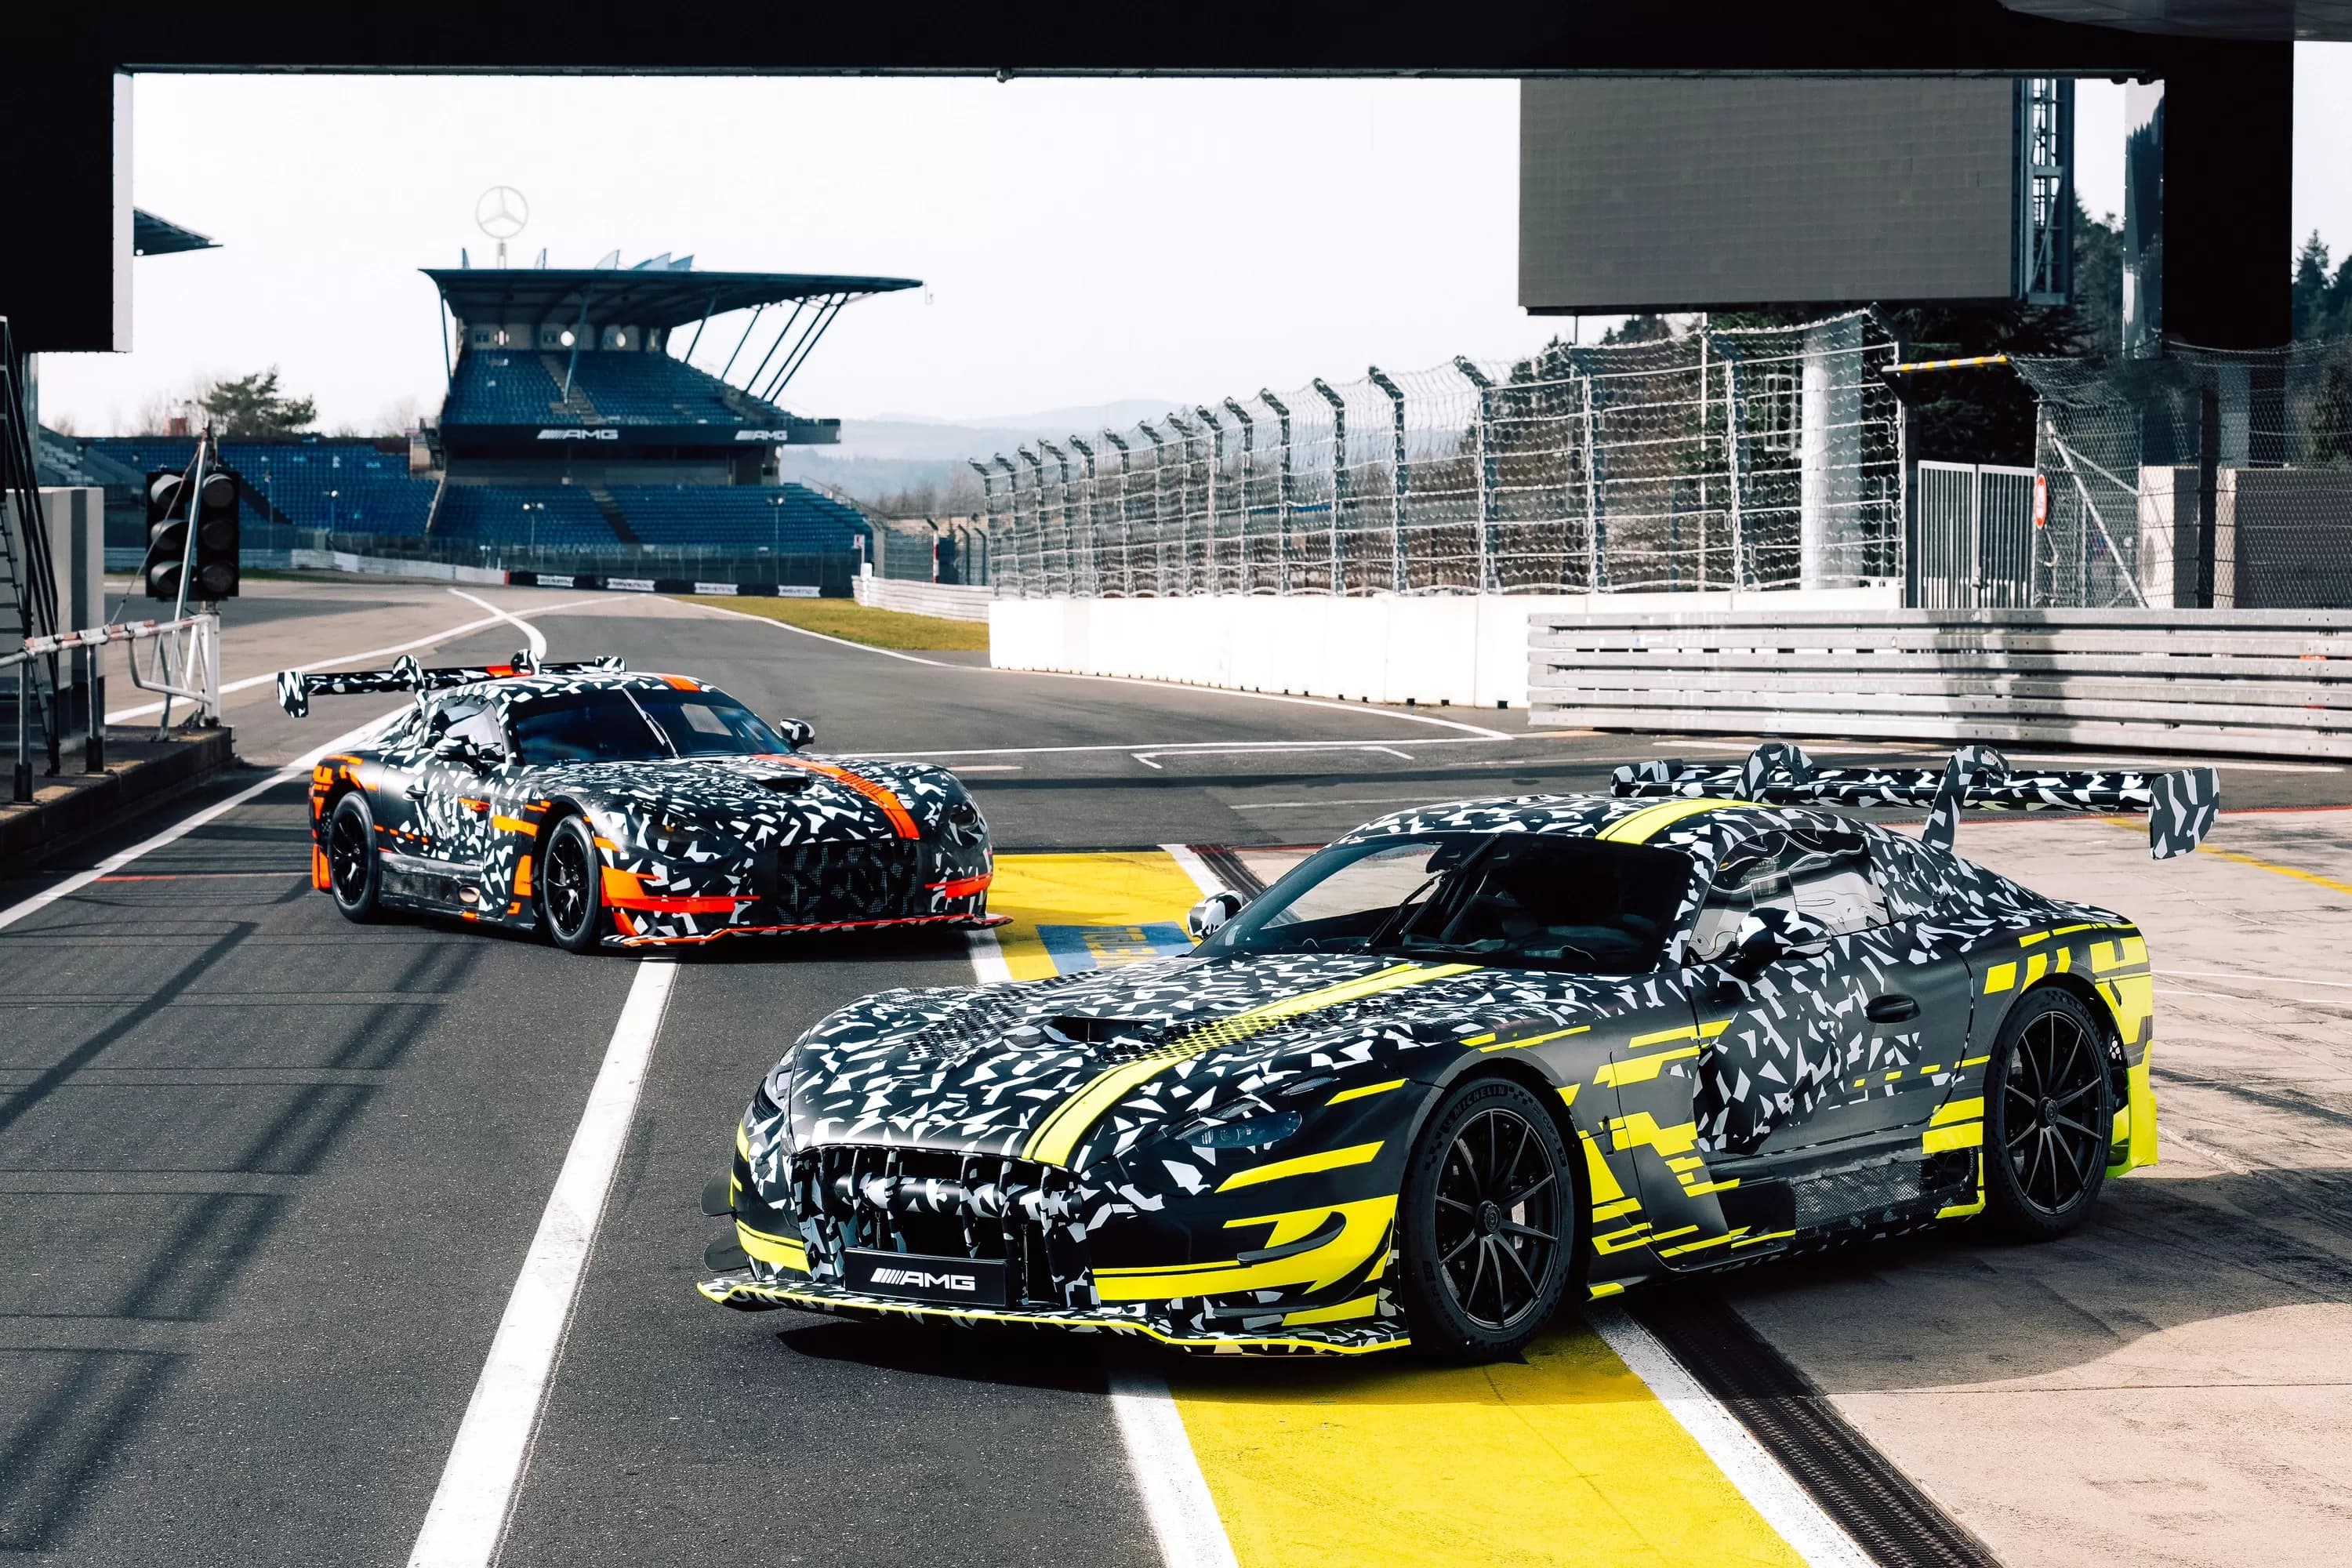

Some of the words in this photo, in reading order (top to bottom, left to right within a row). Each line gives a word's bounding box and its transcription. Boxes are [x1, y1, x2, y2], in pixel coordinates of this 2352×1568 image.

[564, 429, 619, 440] AMG
[1454, 1085, 1506, 1117] MICHELIN
[899, 1271, 976, 1291] AMG
